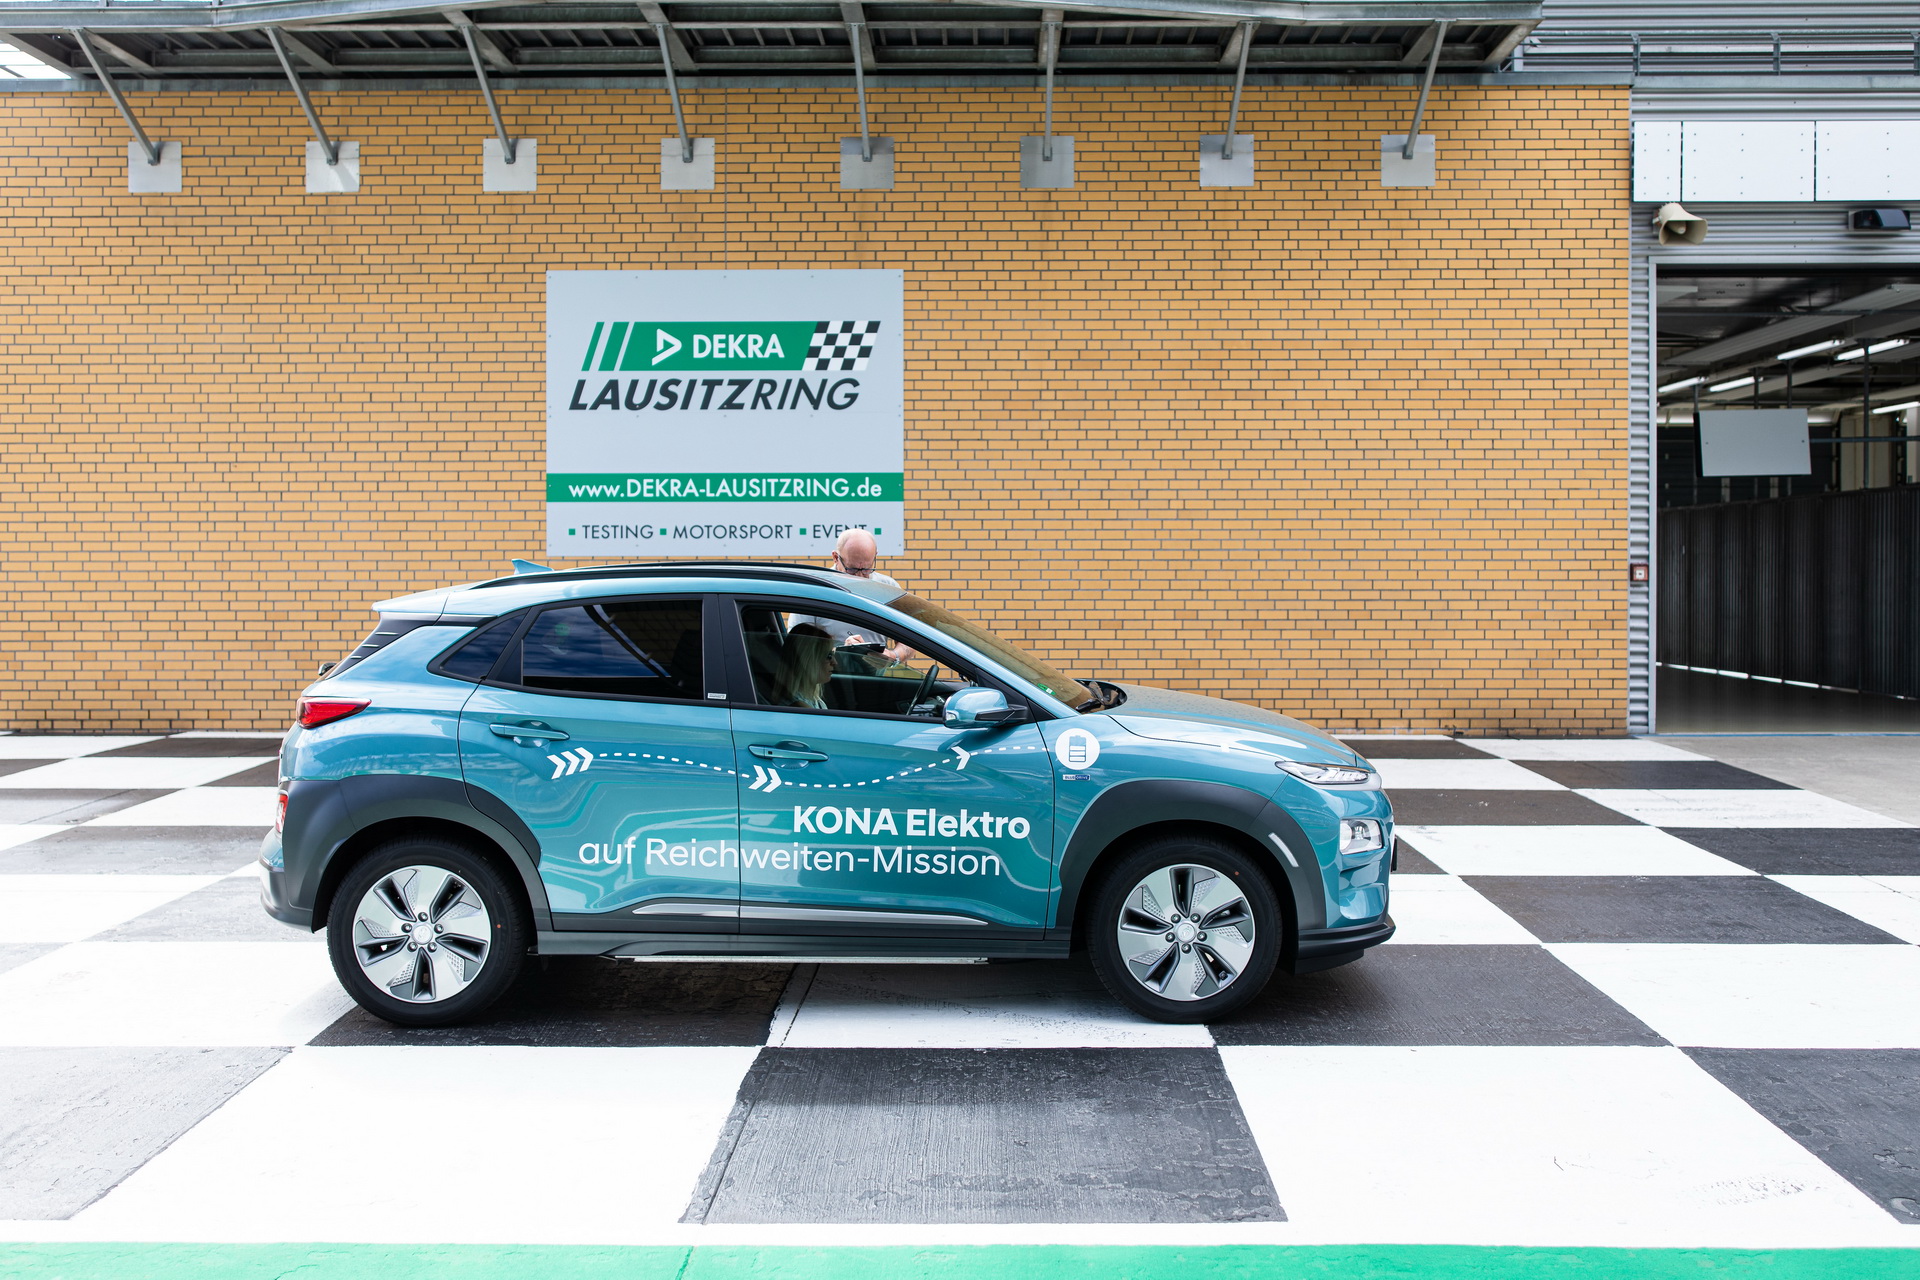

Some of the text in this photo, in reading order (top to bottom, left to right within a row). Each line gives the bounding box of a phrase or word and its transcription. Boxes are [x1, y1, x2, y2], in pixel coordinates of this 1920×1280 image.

[692, 333, 785, 359] DEKRA
[568, 377, 861, 411] LAUSITZRING
[568, 476, 883, 498] www.DEKRA-LAUSITZRING.de
[582, 524, 654, 540] TESTING
[673, 524, 793, 540] MOTORSPORT
[793, 805, 1031, 840] KONA Elektro
[578, 837, 1001, 877] auf Reichweiten-Mission
